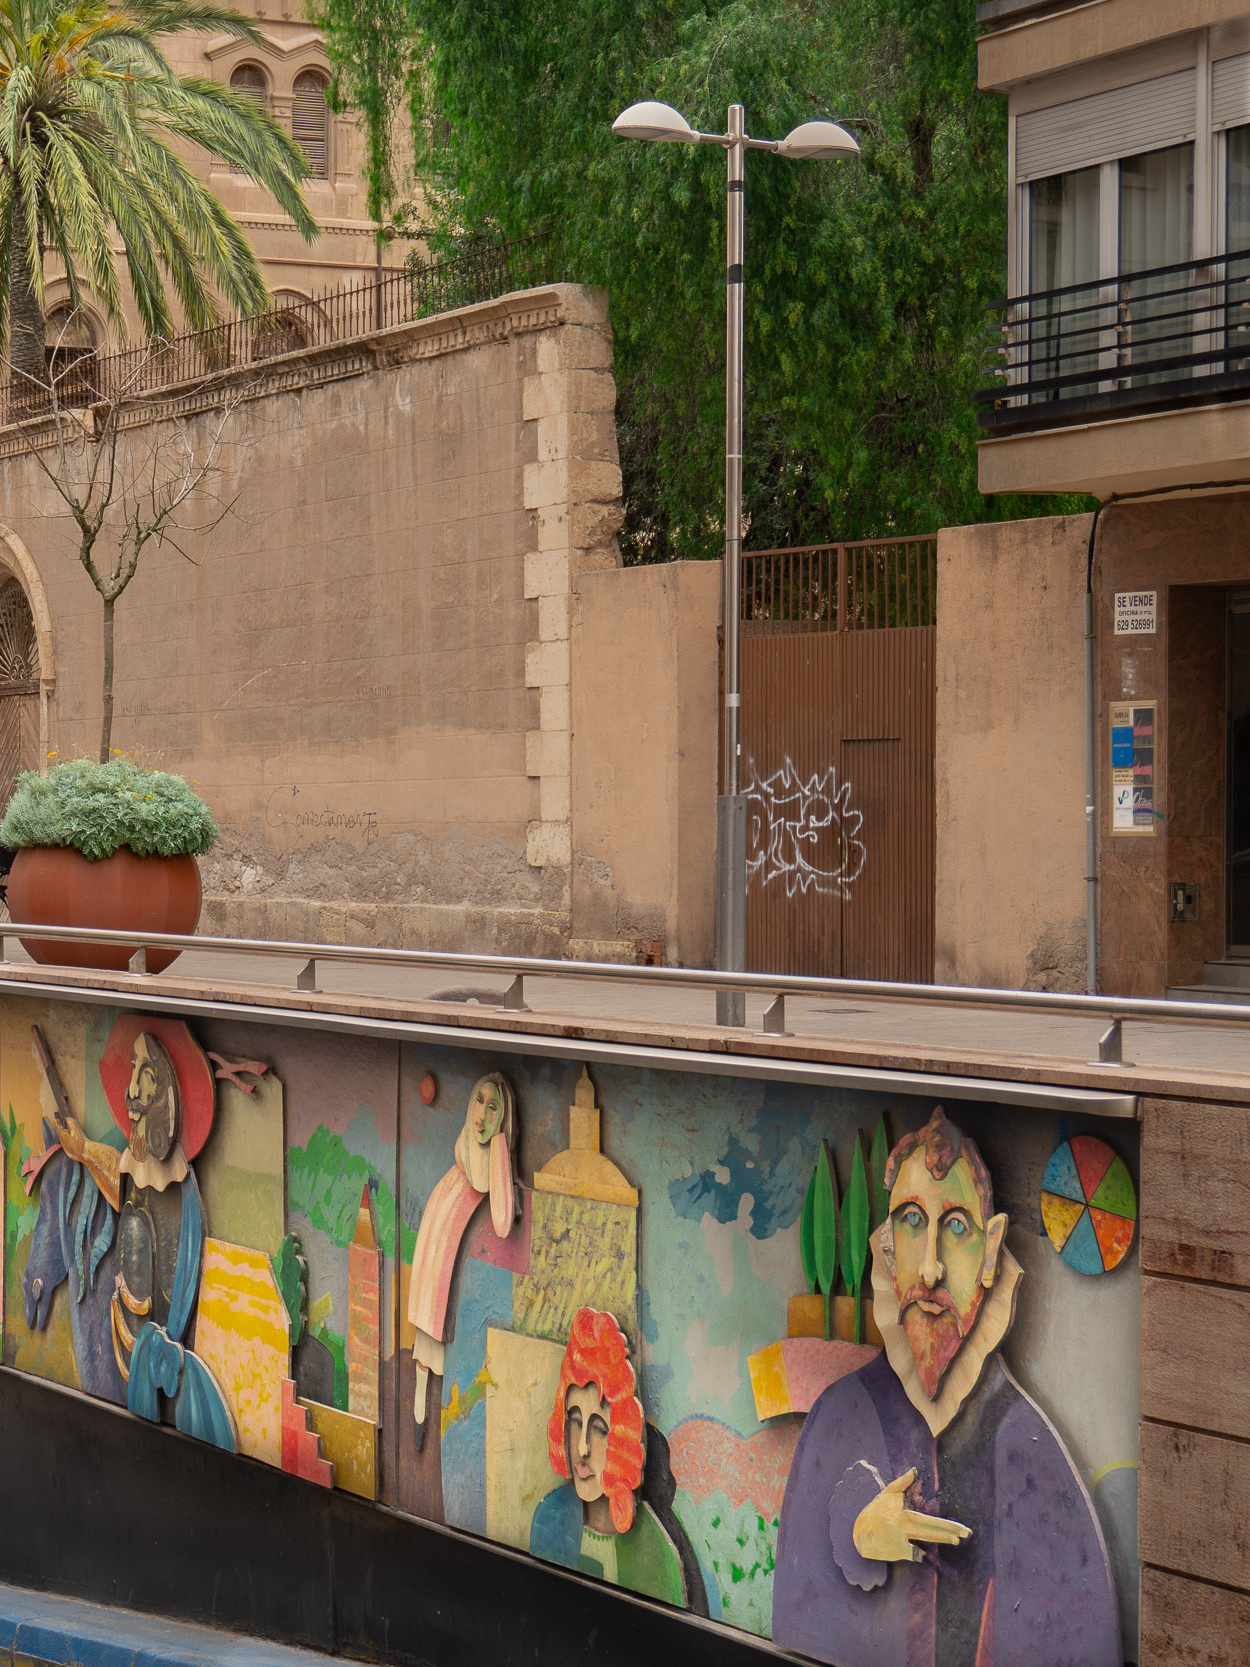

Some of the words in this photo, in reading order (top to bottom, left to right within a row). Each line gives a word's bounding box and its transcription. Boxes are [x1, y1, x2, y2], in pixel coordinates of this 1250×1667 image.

[1117, 596, 1127, 608] SE
[1129, 594, 1154, 607] VENDE
[1118, 609, 1138, 617] OFICINA
[1117, 619, 1129, 631] 629
[1130, 618, 1154, 630] 526991
